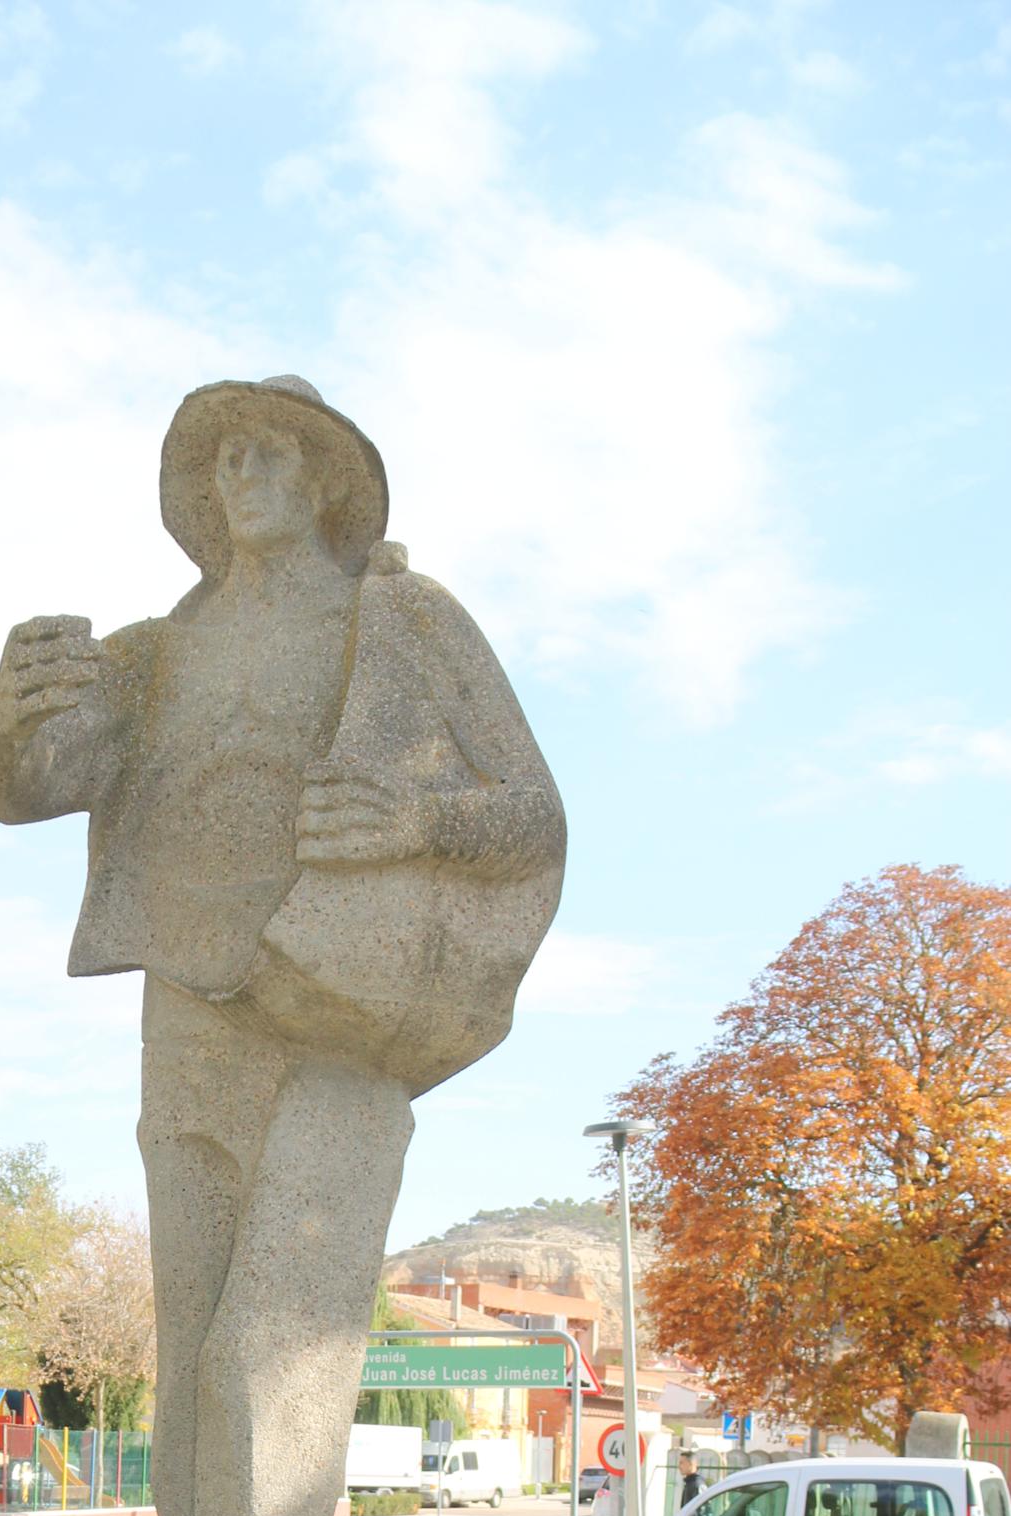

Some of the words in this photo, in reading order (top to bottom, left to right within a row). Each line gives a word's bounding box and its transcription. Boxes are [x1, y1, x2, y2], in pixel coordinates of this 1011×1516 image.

[363, 1367, 397, 1381] Juan
[401, 1366, 436, 1381] José
[443, 1366, 487, 1381] Lucas
[494, 1366, 559, 1381] Jiménez
